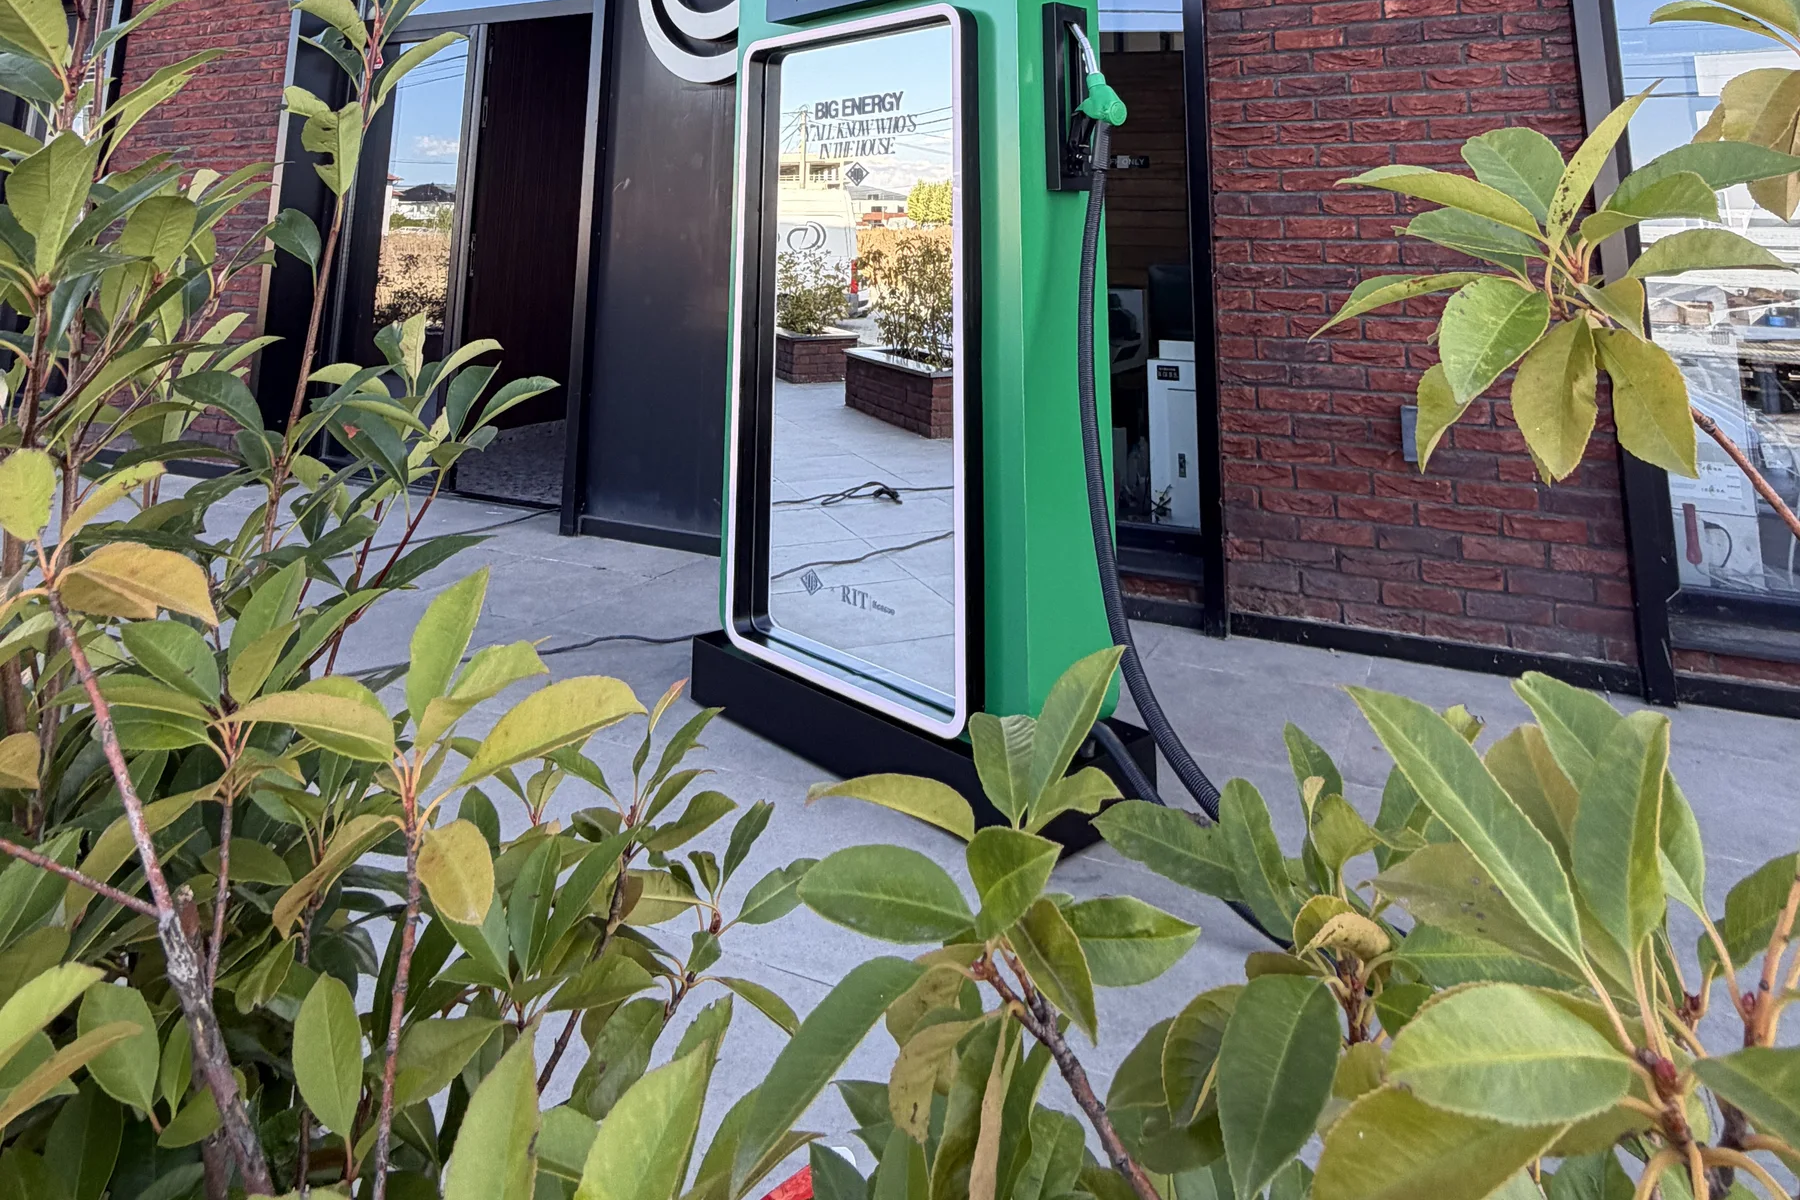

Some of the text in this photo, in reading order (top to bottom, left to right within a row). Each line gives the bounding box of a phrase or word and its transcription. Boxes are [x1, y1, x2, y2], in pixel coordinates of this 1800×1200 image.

[814, 90, 904, 120] BIG ENERGY
[836, 120, 873, 140] KNOW
[874, 114, 917, 135] WHO'S
[833, 140, 855, 159] THE
[855, 137, 896, 157] HOUSE
[1121, 158, 1145, 166] ONLY
[841, 584, 868, 610] RIT
